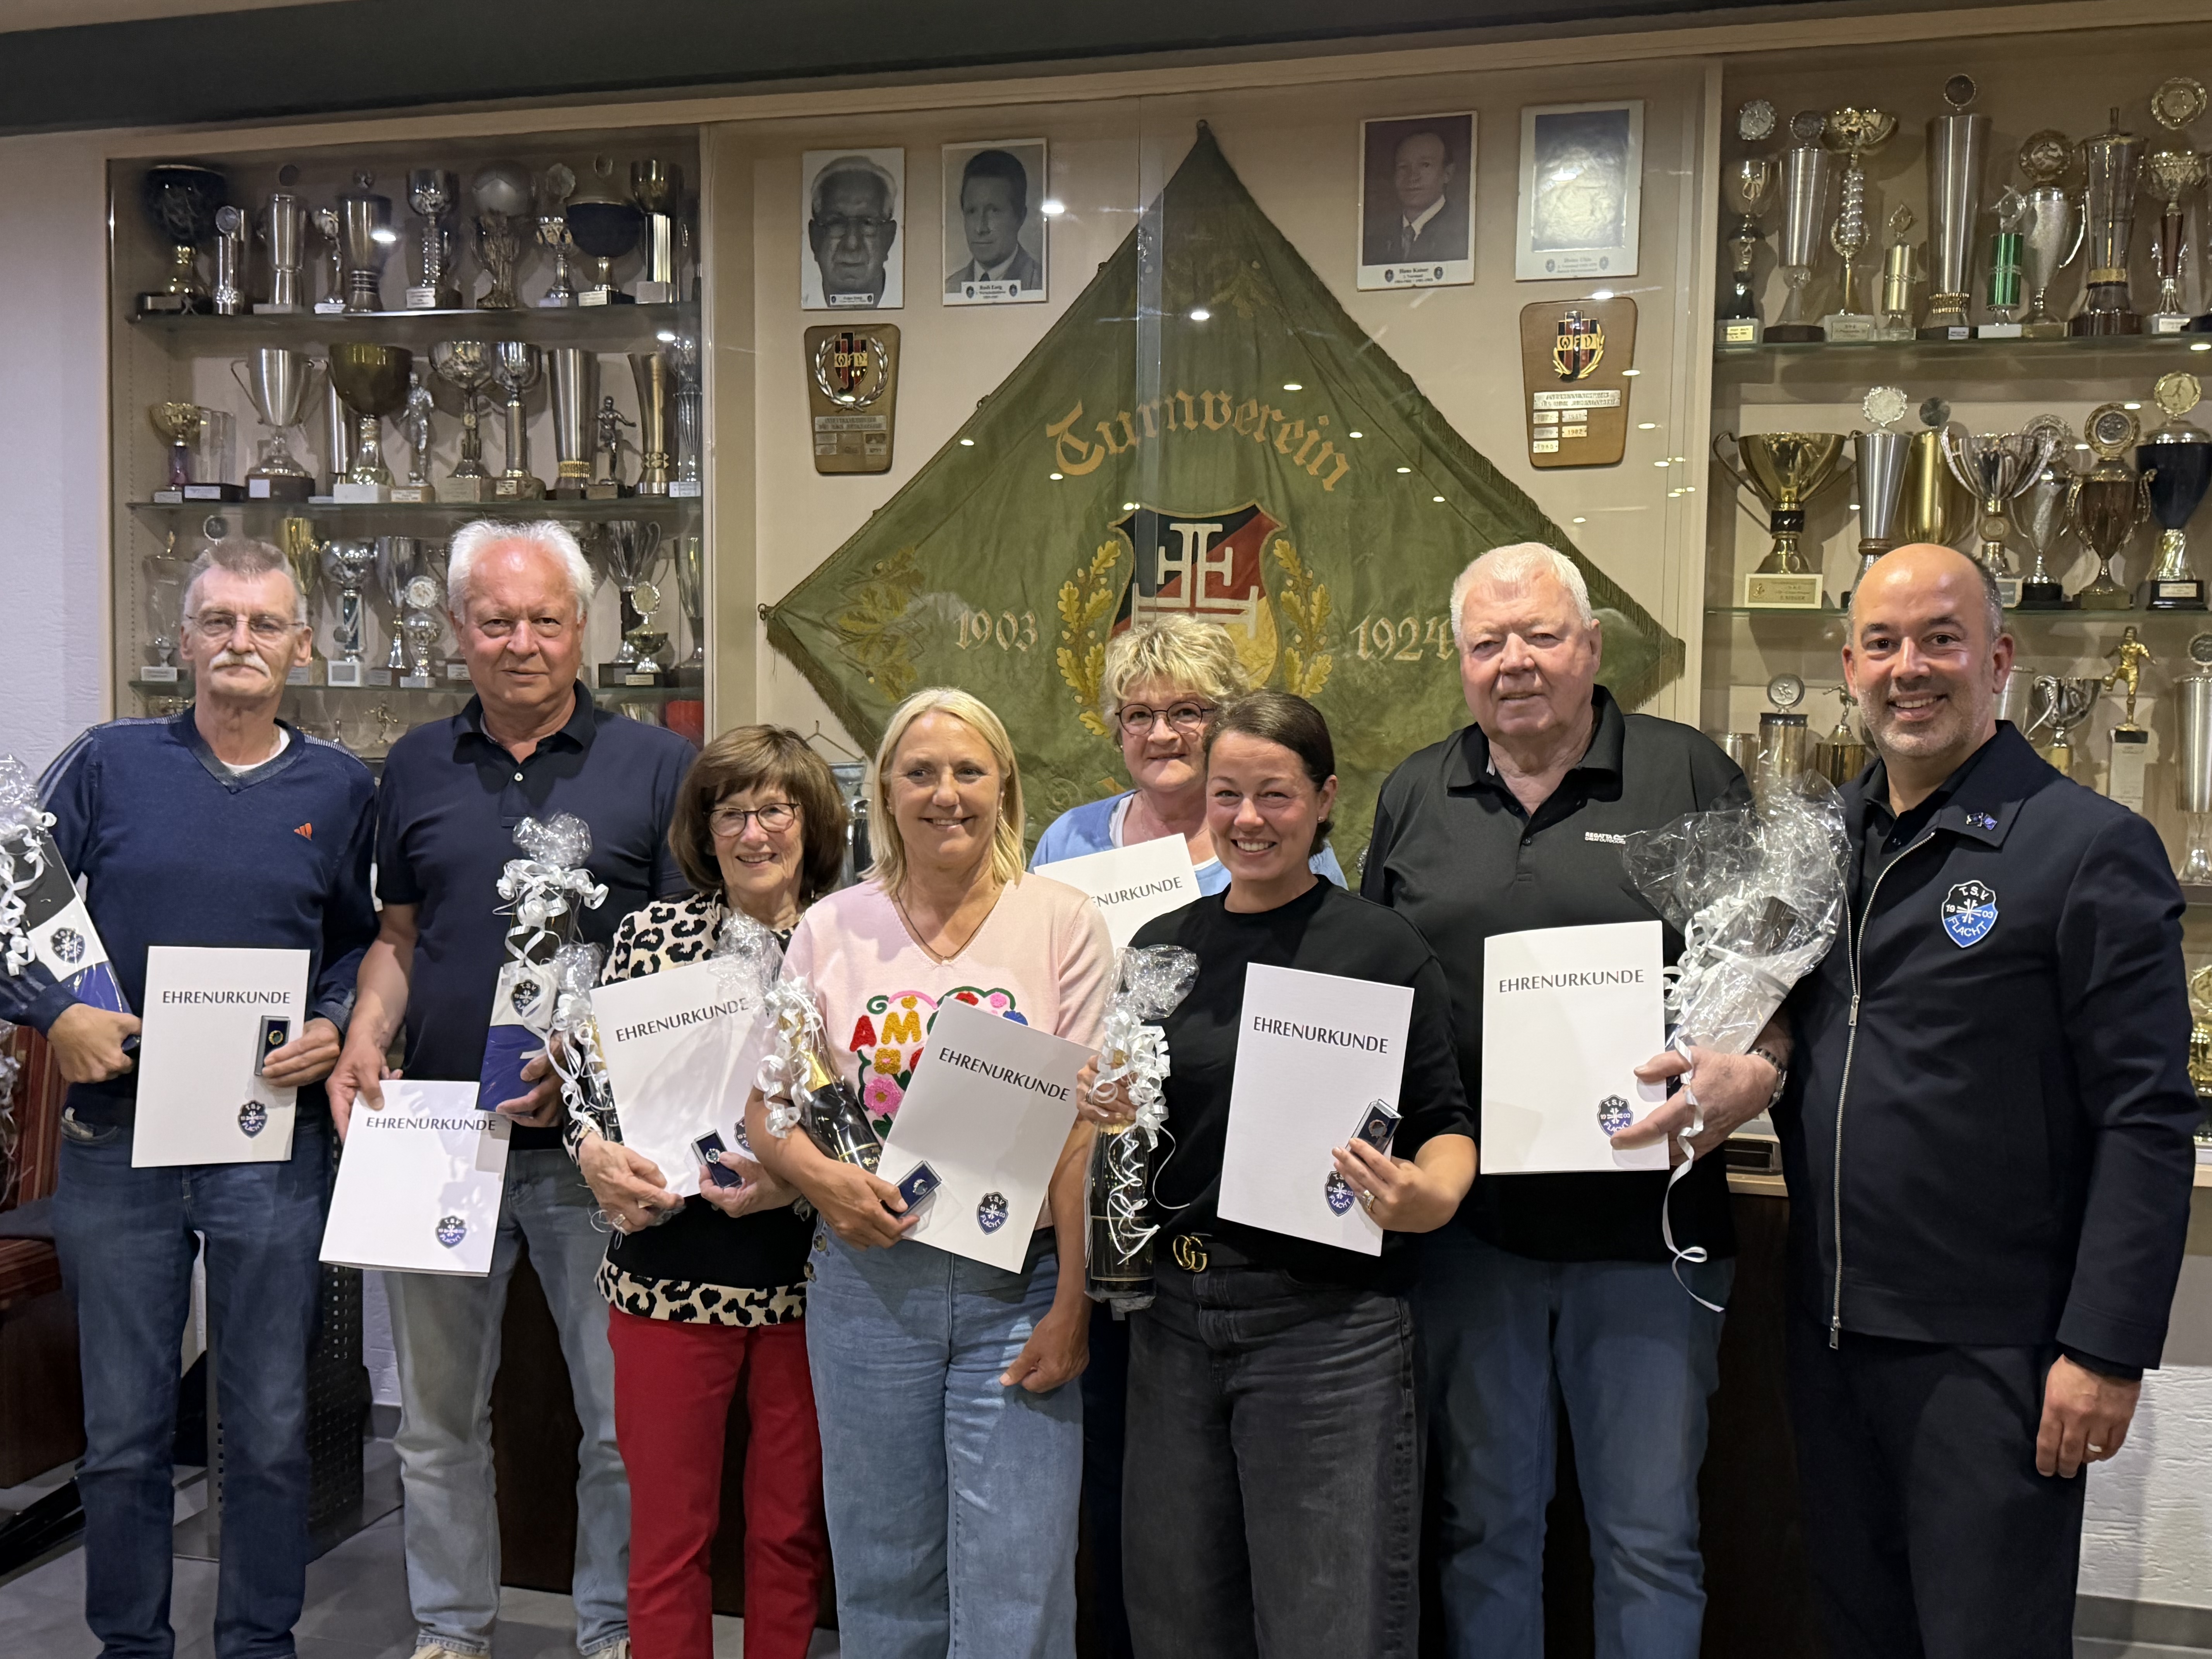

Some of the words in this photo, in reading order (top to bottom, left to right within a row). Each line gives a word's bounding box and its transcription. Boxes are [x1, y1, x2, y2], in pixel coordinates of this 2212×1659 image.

[1046, 390, 1350, 491] Turnverein
[953, 609, 1038, 652] 1903
[1350, 615, 1455, 661] 1924
[1091, 876, 1183, 908] NURKUNDE
[1946, 904, 1955, 912] 19
[1982, 910, 1994, 919] 03
[1948, 917, 1987, 936] FLACHT
[163, 991, 291, 1004] EHRENURKUNDE
[1499, 969, 1644, 993] EHRENURKUNDE
[616, 997, 749, 1042] EHRENURKUNDE
[849, 1010, 939, 1052] AM
[1253, 1016, 1389, 1054] EHRENURKUNDE
[939, 1047, 1070, 1101] EHRENURKUNDE
[367, 1117, 496, 1131] EHRENURKUNDE
[980, 1214, 1001, 1228] FLACHT
